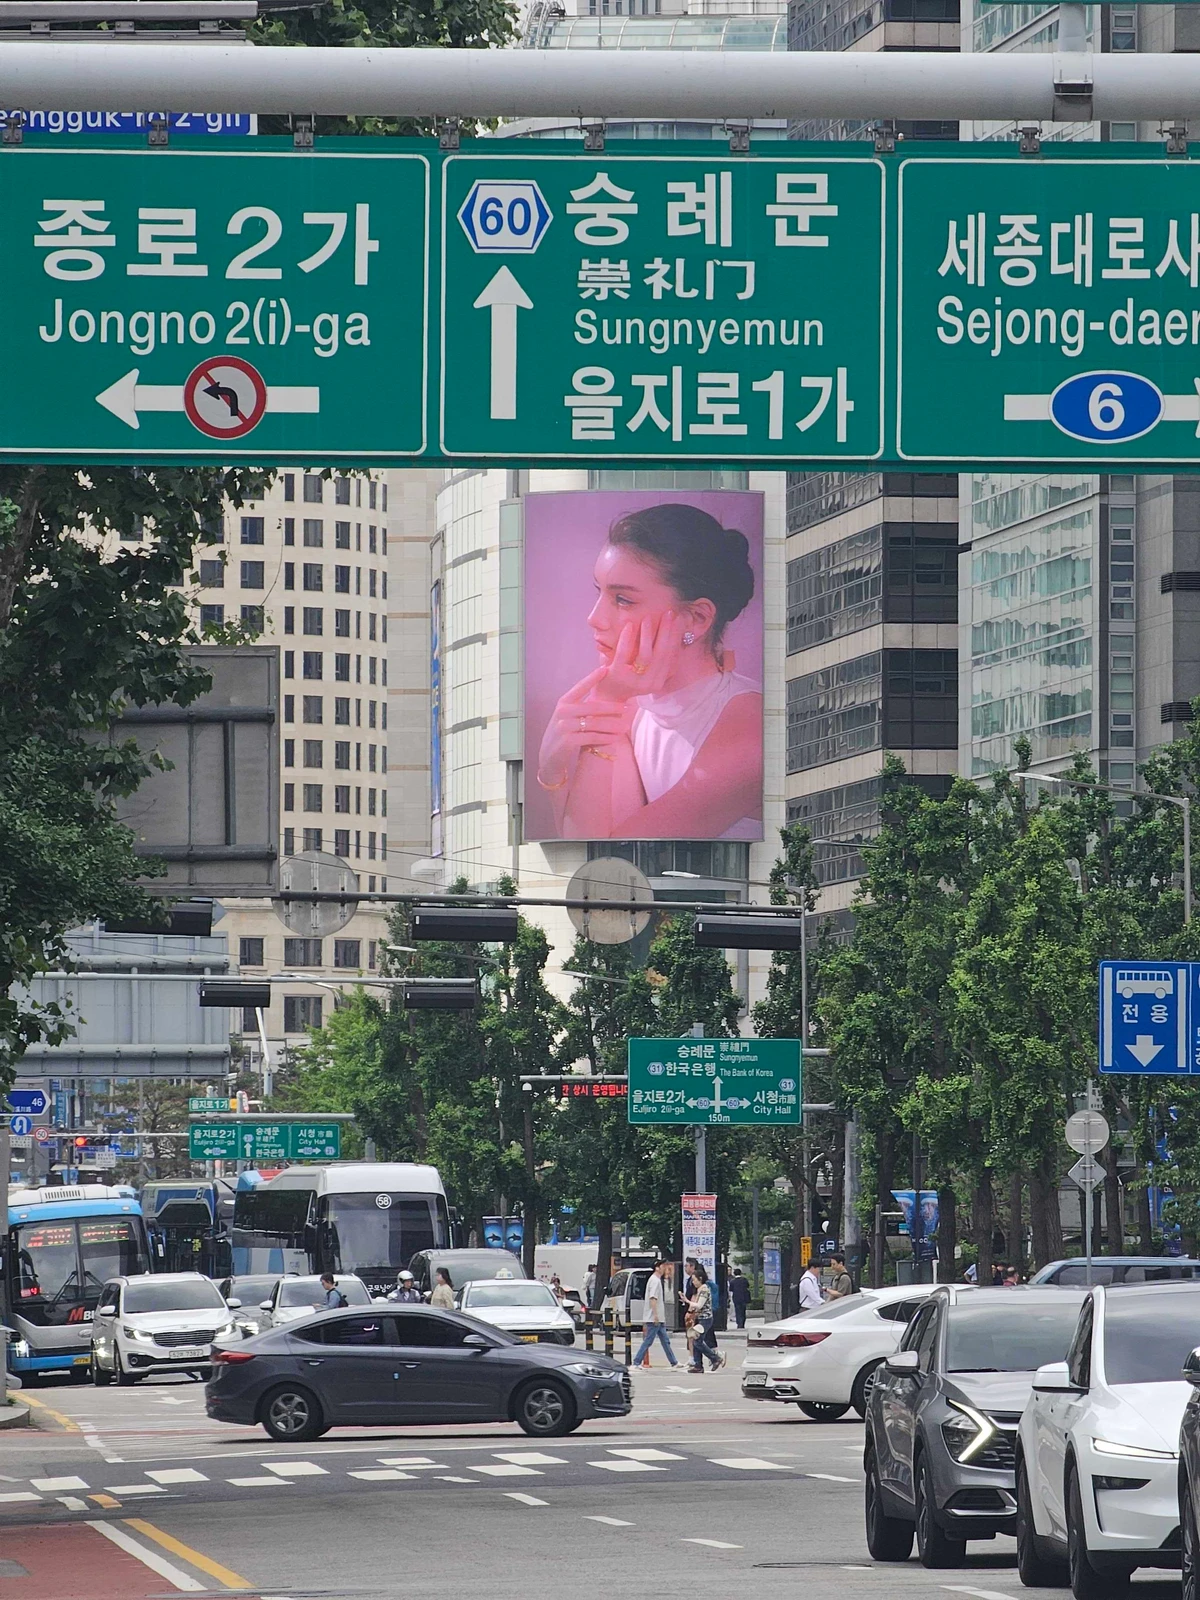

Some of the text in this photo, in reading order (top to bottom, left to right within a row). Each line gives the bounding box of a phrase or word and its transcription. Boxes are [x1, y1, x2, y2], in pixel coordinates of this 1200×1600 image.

[479, 197, 532, 236] 60
[566, 171, 839, 247] 숭례문
[34, 199, 380, 286] 종로2가
[937, 212, 1200, 288] 세종대로사
[577, 257, 756, 301] 崇礼门
[39, 297, 371, 358] Jongno 2(i)-ga
[574, 309, 824, 354] Sungnyemun
[936, 294, 1200, 357] Sejong-daer
[564, 366, 855, 443] 을지로1가
[1088, 382, 1125, 432] 6
[1121, 1003, 1169, 1024] 전용
[677, 1044, 716, 1059] 숭례문
[719, 1053, 759, 1064] Sungnyemun
[651, 1062, 716, 1077] 31 한국은행
[720, 1068, 774, 1077] The Bank of Korea
[573, 1084, 589, 1096] 상시
[782, 1081, 793, 1090] 31
[31, 1097, 43, 1107] 46
[632, 1089, 686, 1104] 을지로2가
[698, 1098, 709, 1108] 60
[728, 1098, 739, 1108] 60
[753, 1090, 779, 1105] 시청
[708, 1113, 731, 1122] 150m
[753, 1105, 792, 1116] City Hall
[193, 1129, 236, 1139] 을지로2가
[298, 1129, 316, 1138] 시청
[378, 1196, 390, 1206] 58
